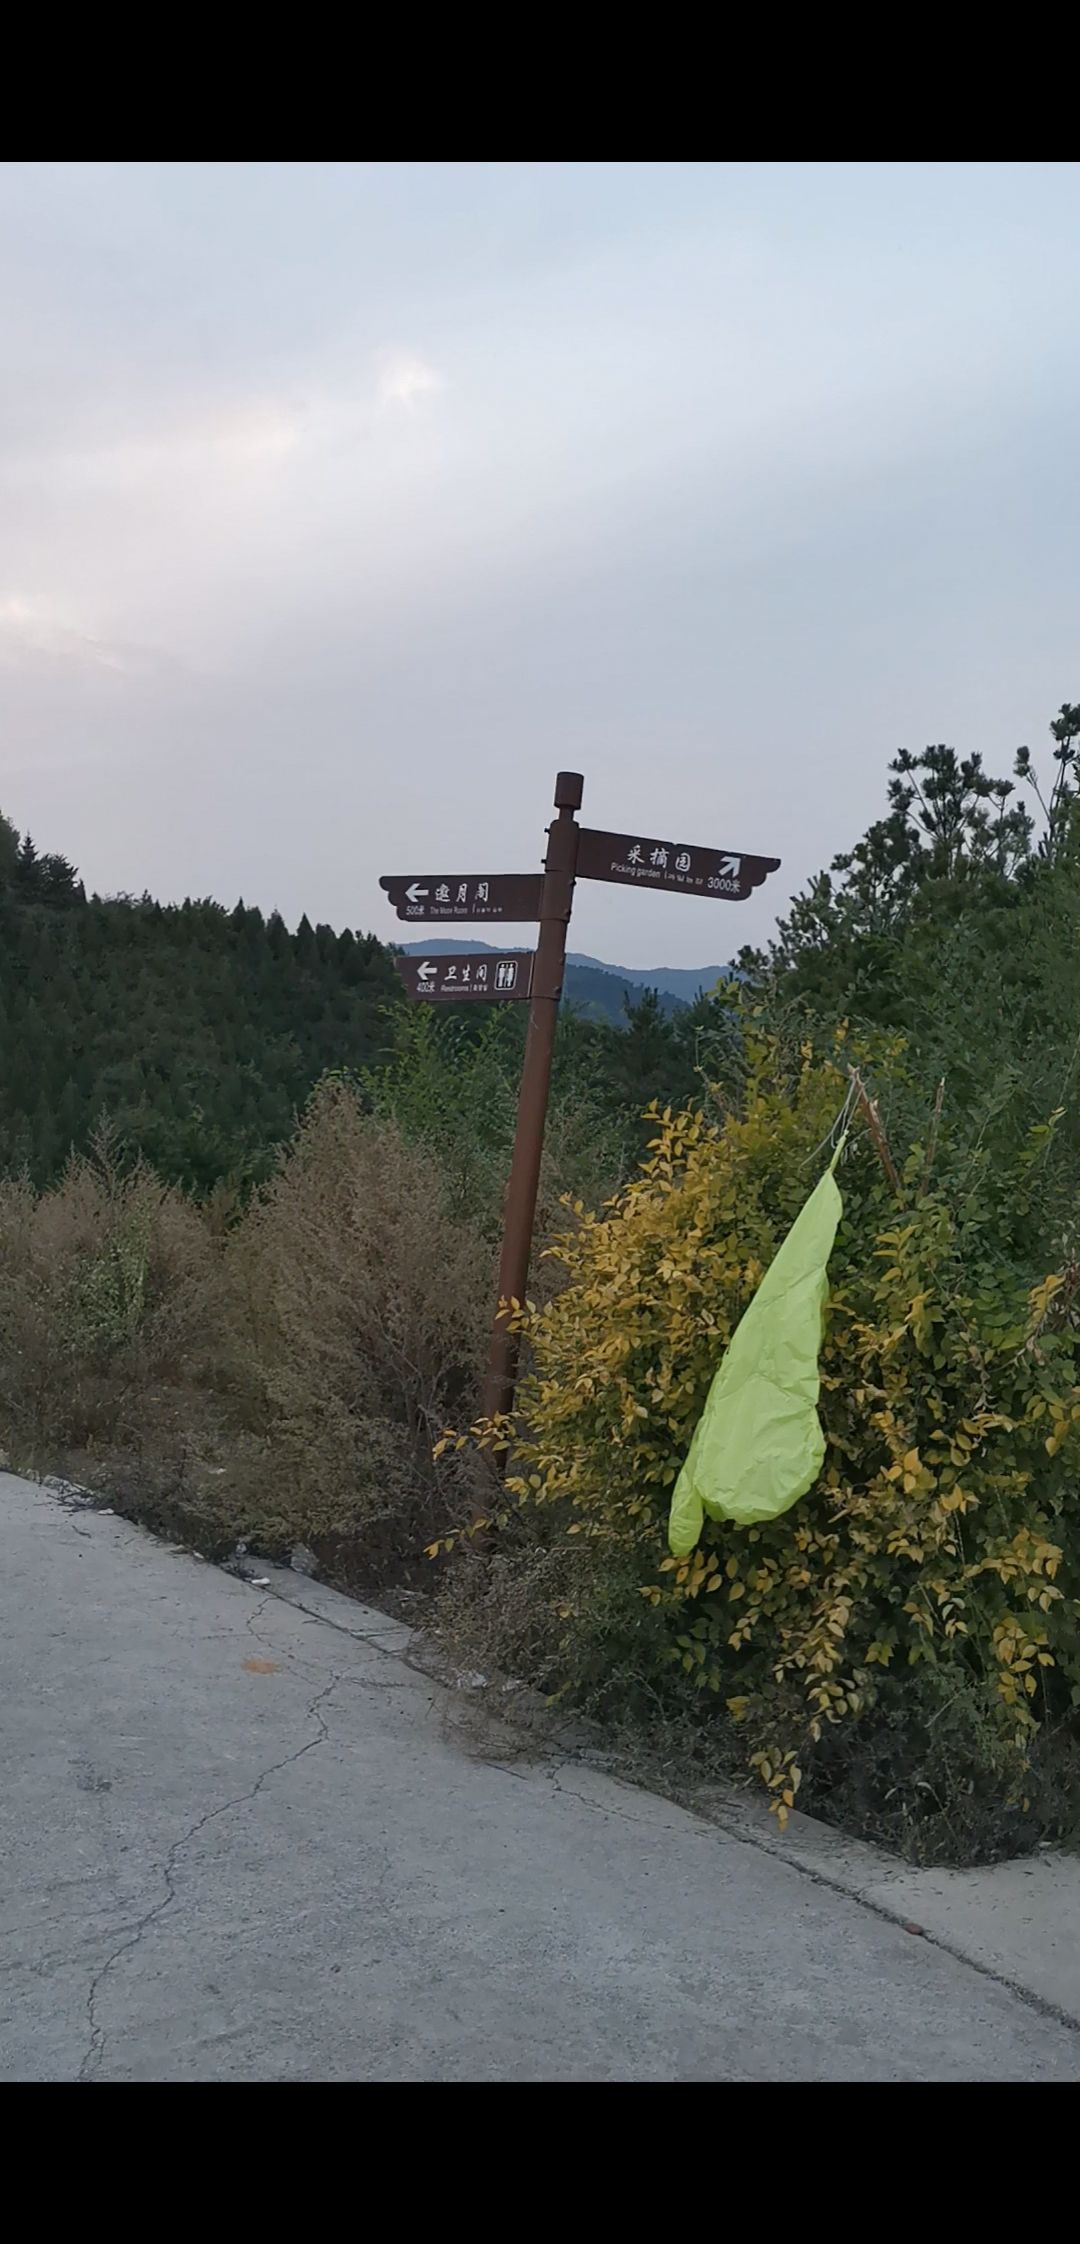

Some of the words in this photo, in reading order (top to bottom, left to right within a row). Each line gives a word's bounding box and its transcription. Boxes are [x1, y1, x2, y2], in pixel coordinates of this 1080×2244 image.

[627, 845, 691, 872] 采摘园
[611, 862, 636, 877] Picking
[637, 867, 661, 879] garden
[707, 877, 742, 893] 3000米
[444, 964, 488, 982] 卫生间
